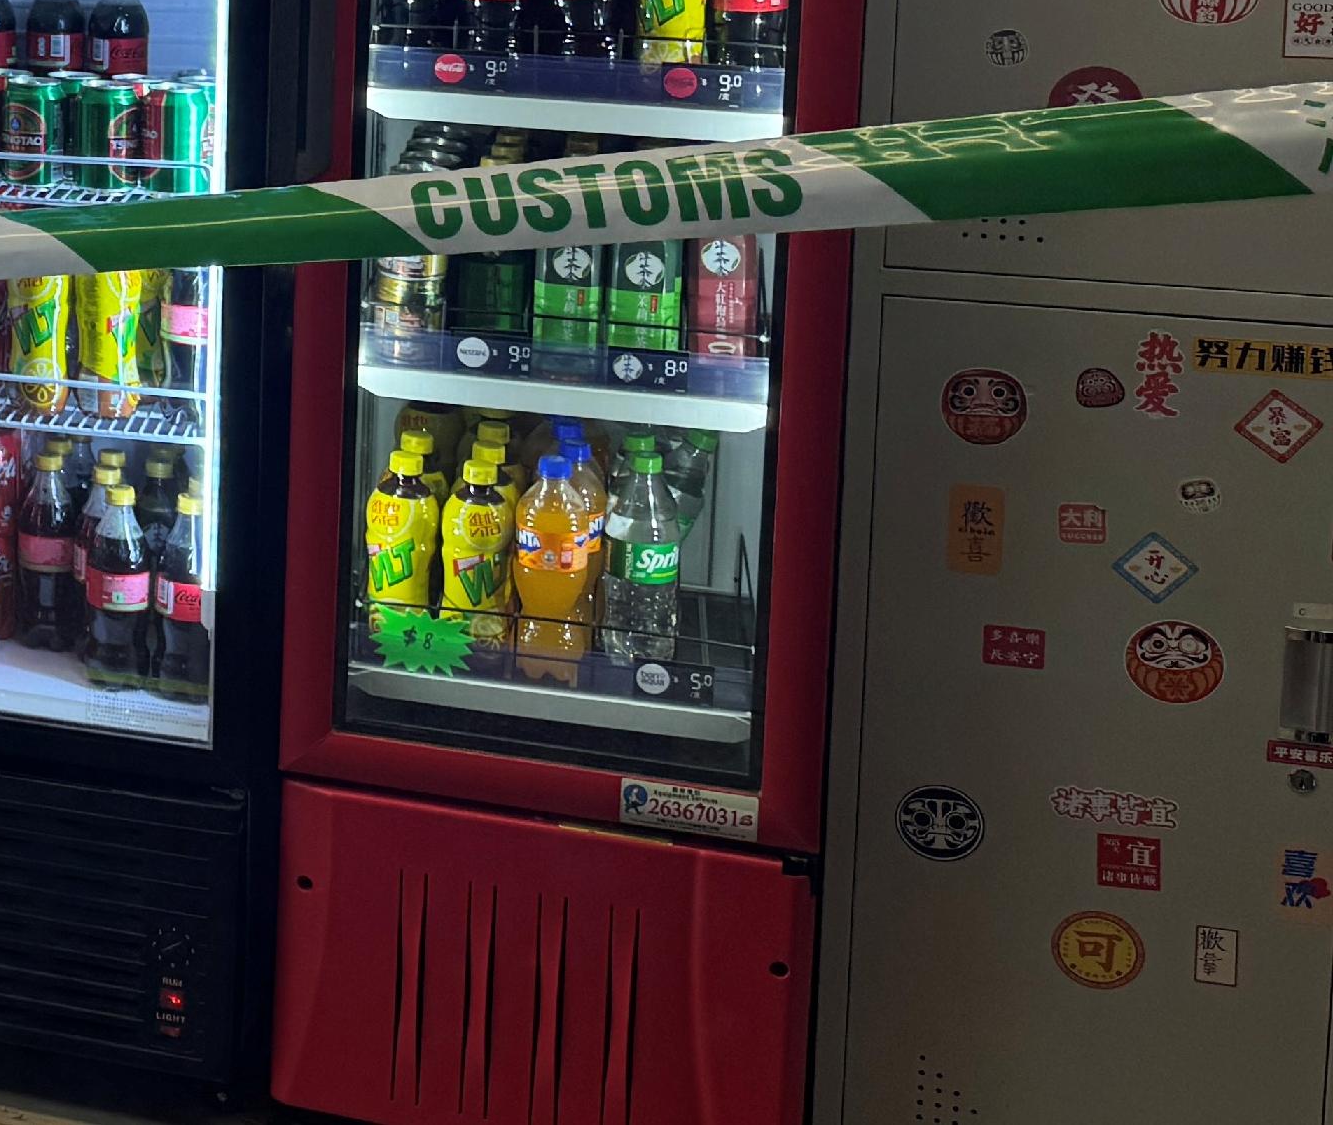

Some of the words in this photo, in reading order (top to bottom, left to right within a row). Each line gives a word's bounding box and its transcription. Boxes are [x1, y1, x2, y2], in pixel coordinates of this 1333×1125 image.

[720, 74, 743, 92] 9.0
[410, 149, 802, 240] CUSTOMS
[508, 346, 530, 363] 9.0
[1196, 339, 1333, 374] 努力赚钱
[665, 359, 688, 376] 8.0
[690, 673, 713, 690] 5.0
[648, 798, 738, 827] 26367031
[1126, 841, 1157, 868] 宜
[1076, 930, 1124, 972] 可
[156, 1012, 185, 1023] LIGHT
